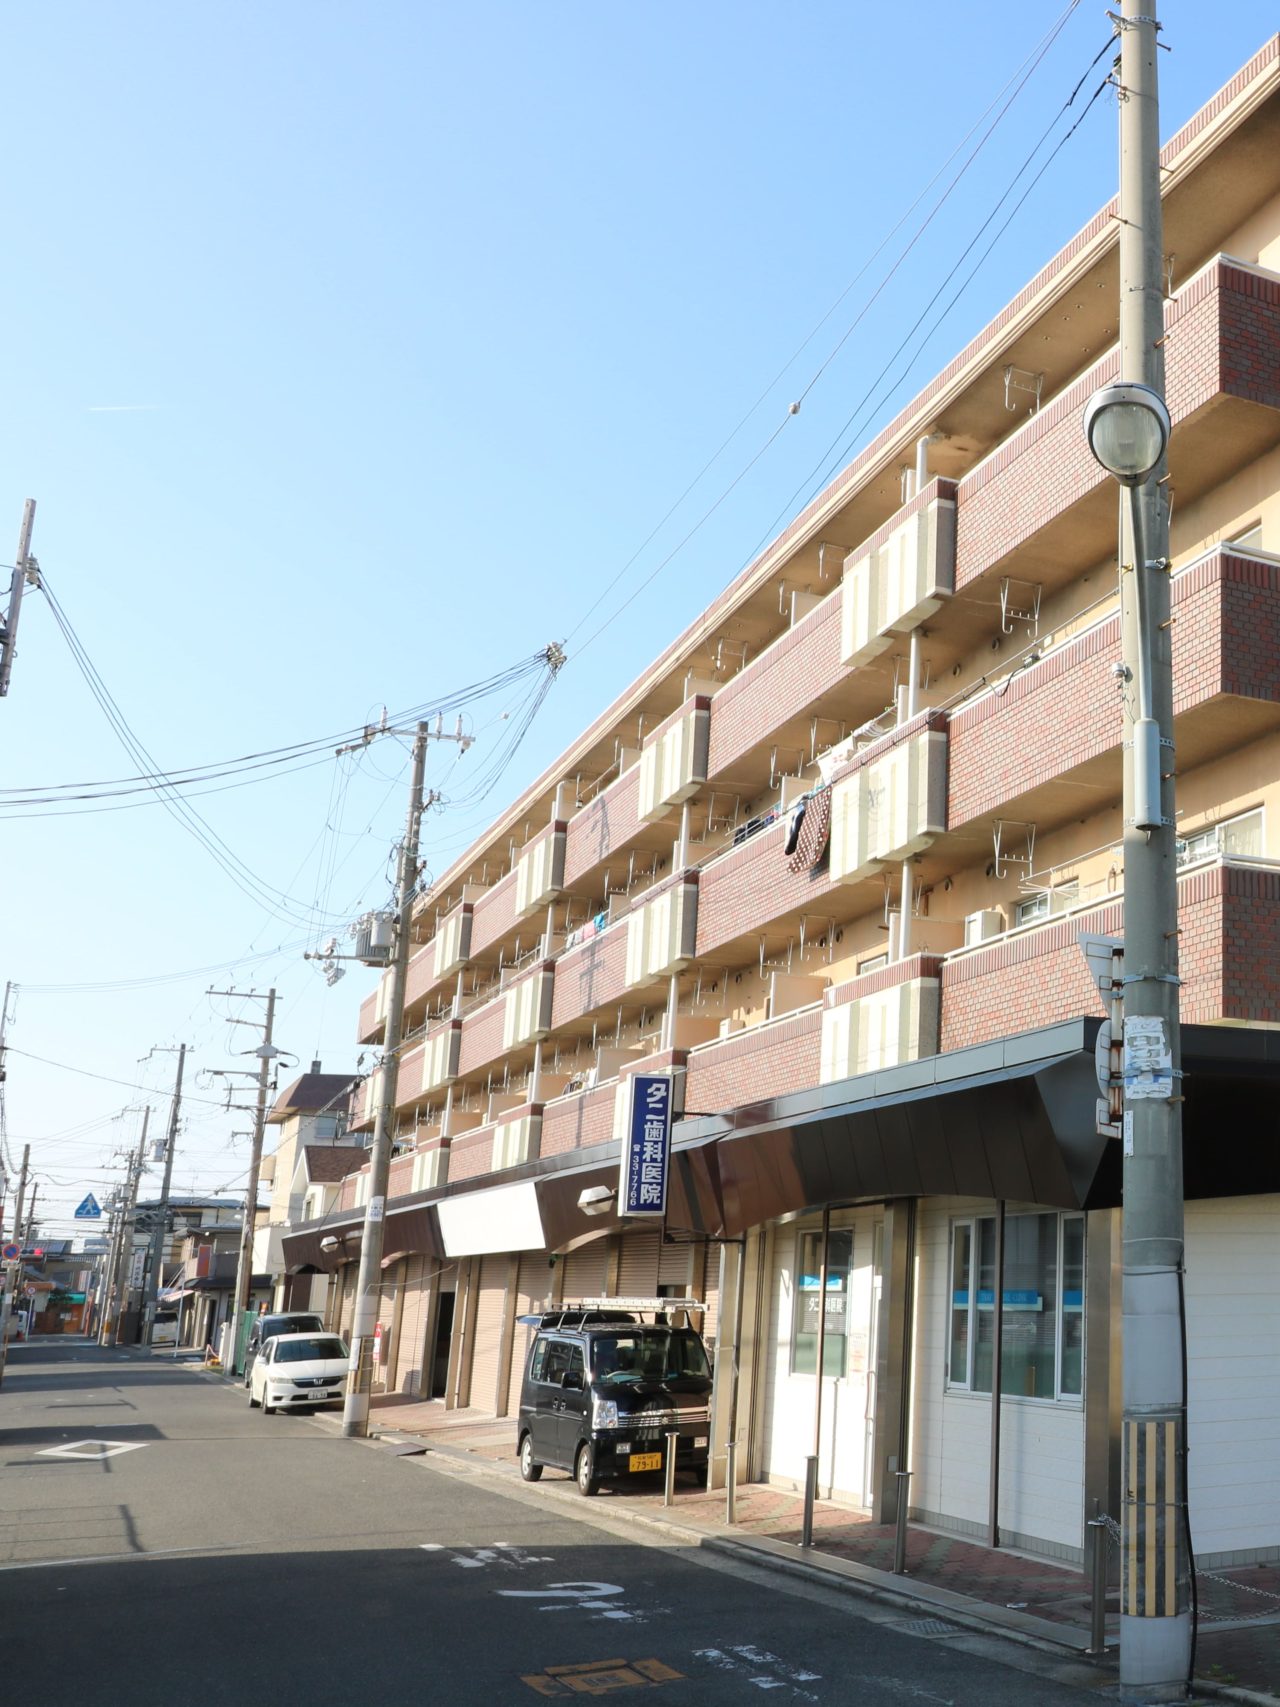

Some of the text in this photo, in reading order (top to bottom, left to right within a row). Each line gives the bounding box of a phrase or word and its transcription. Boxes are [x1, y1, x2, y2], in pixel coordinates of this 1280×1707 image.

[640, 1083, 667, 1204] タニ歯科医院
[808, 1297, 843, 1312] タニ科医院
